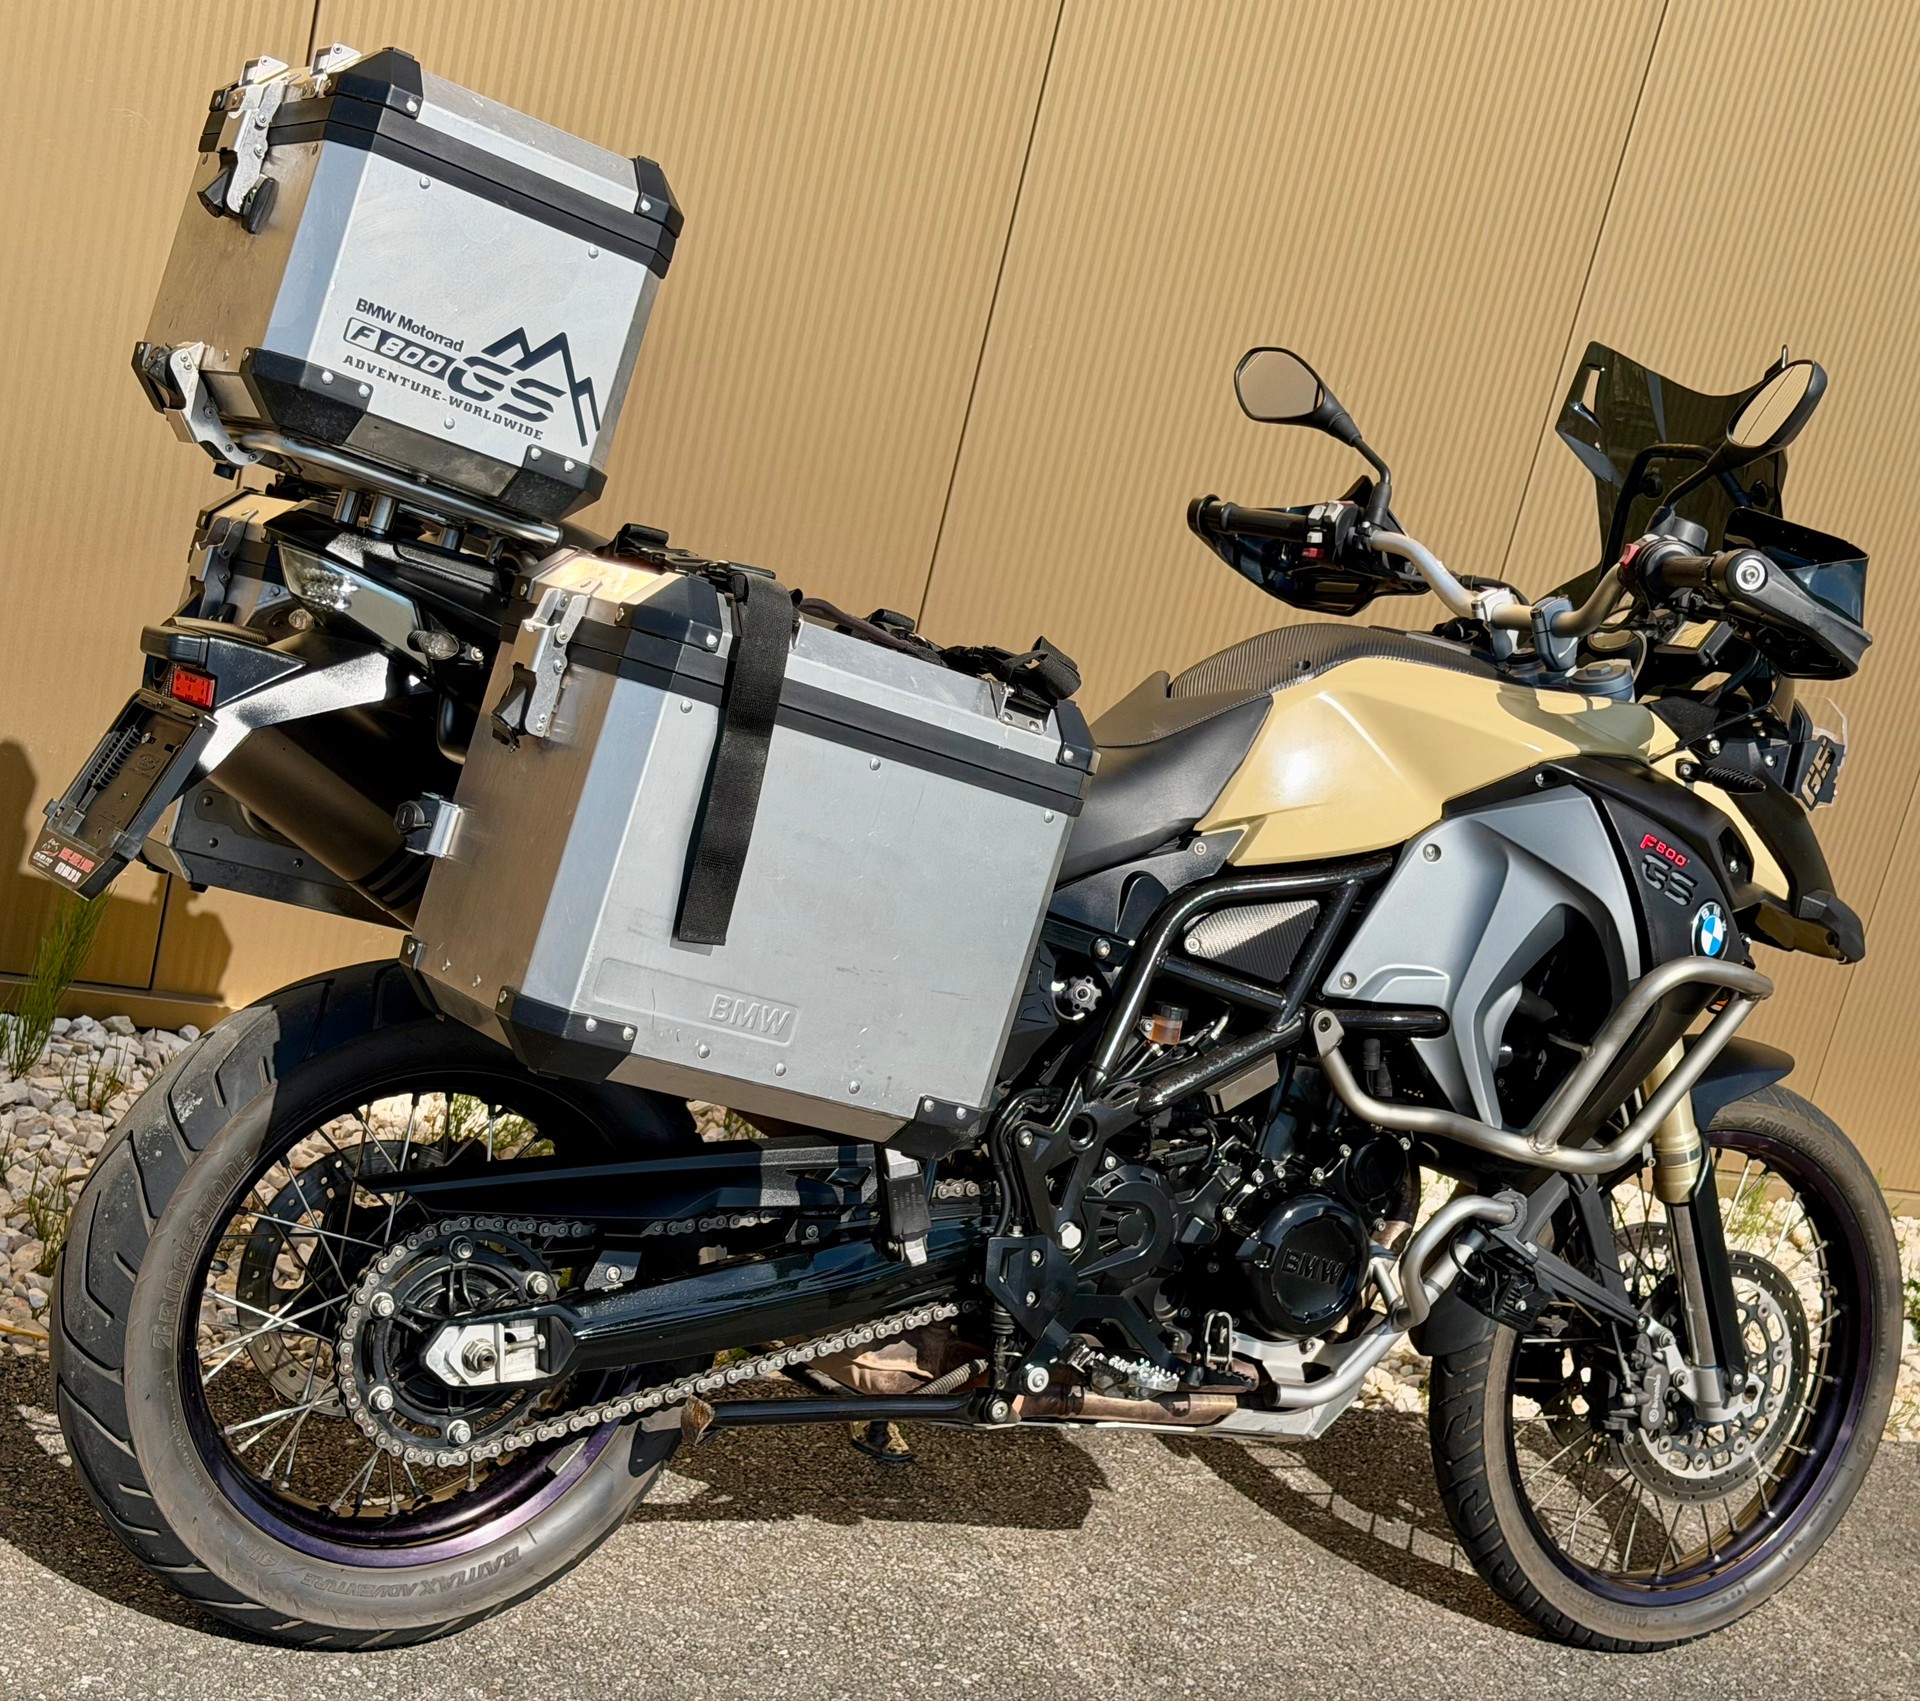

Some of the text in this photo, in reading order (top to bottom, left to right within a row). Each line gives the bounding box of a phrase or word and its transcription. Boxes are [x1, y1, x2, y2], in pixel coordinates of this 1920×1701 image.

[355, 298, 464, 352] BMW Motorrad
[342, 354, 544, 441] ADVENTURE-WORLDWIDE
[350, 325, 567, 423] F 800 GS
[1641, 854, 1698, 906] GS
[708, 993, 791, 1036] BMW
[151, 1147, 253, 1351] BRIDGESTONE
[1281, 1248, 1345, 1285] BMW
[299, 1572, 418, 1598] ADVENTURE
